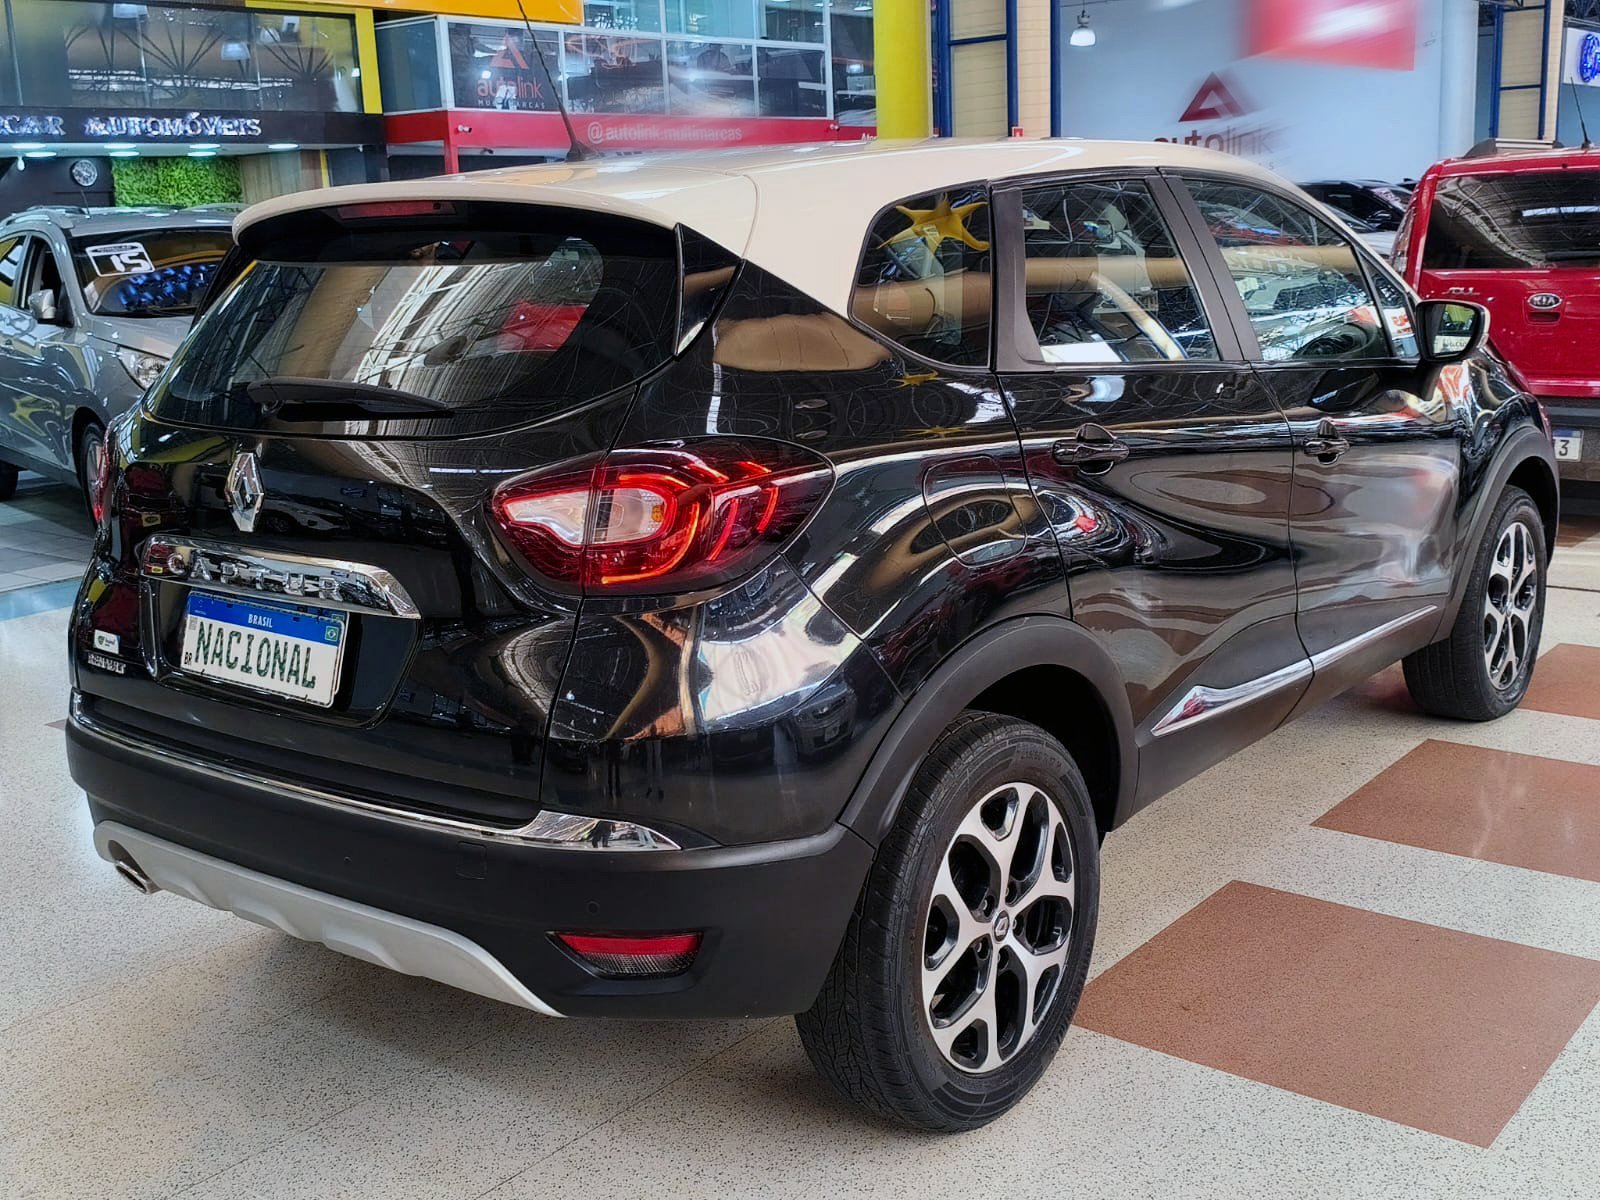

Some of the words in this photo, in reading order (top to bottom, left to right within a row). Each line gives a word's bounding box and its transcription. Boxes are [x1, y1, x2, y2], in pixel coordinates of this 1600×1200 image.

[1532, 294, 1557, 307] KIA
[167, 552, 343, 602] CAPTUR
[248, 613, 273, 628] BRASIL
[184, 651, 193, 666] BR
[194, 621, 316, 688] NACIONAL
